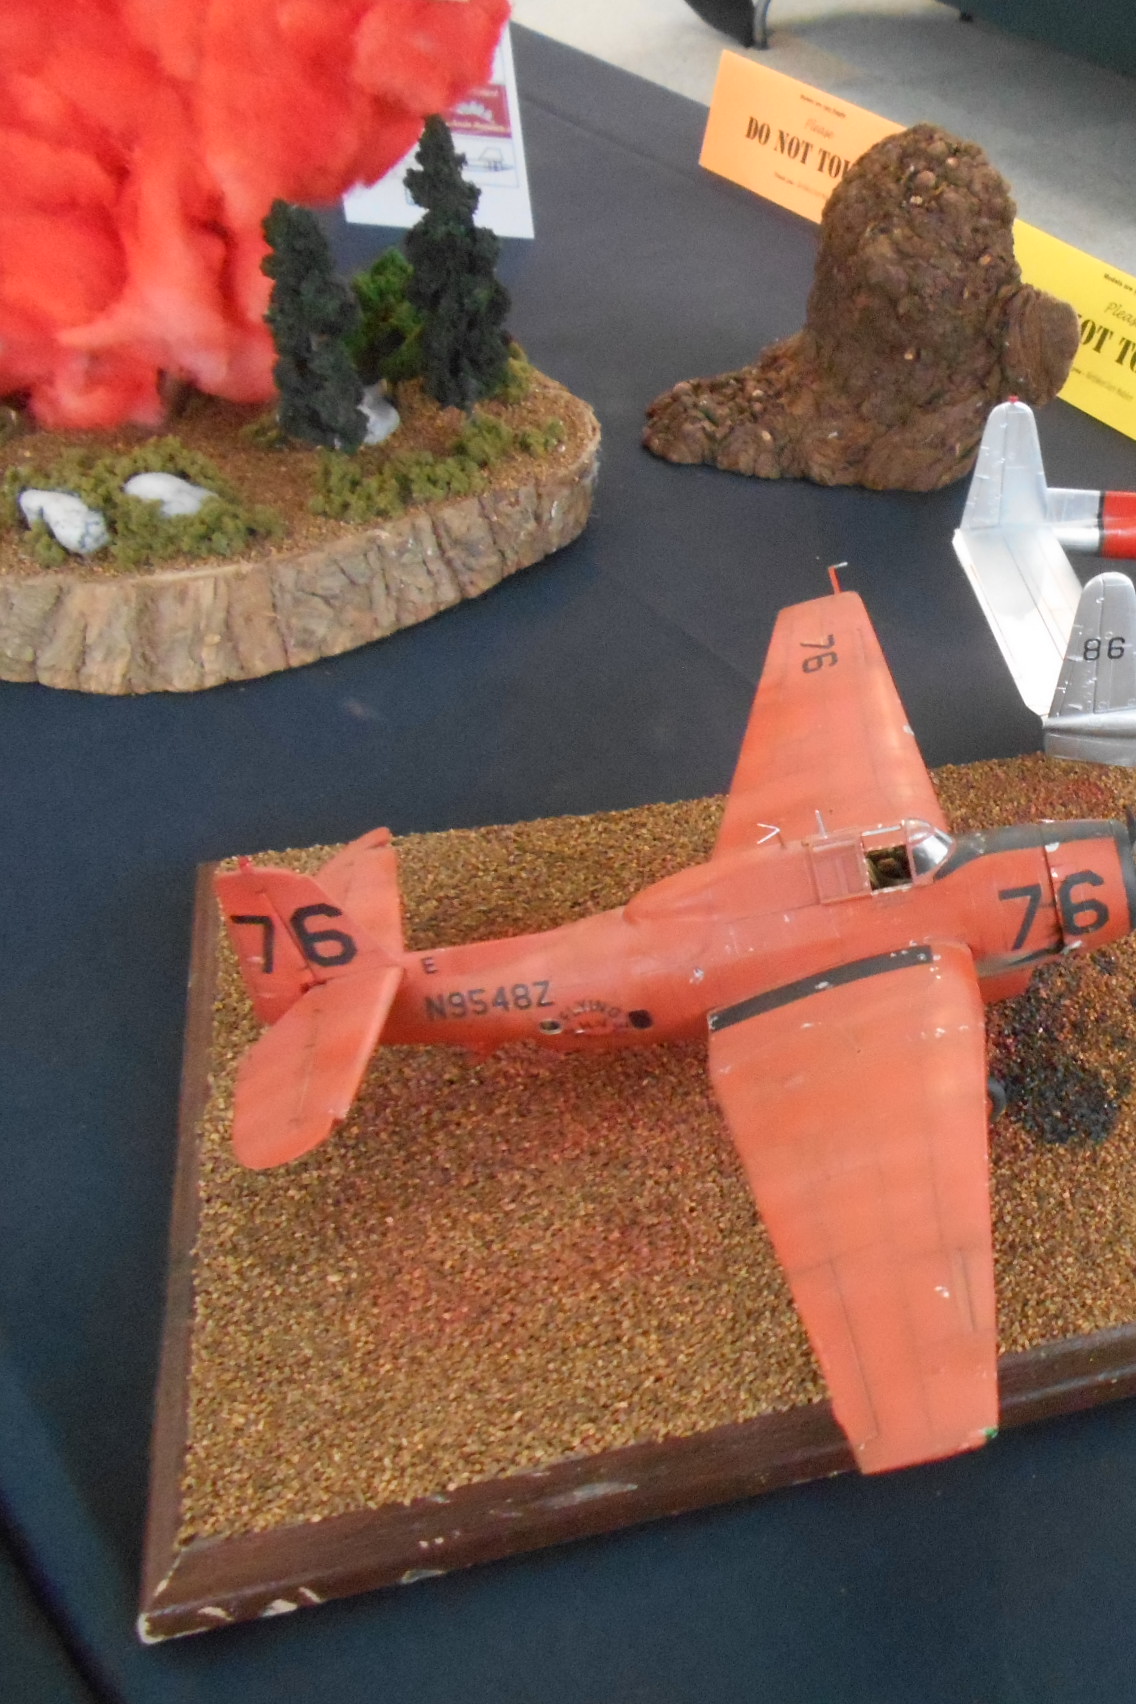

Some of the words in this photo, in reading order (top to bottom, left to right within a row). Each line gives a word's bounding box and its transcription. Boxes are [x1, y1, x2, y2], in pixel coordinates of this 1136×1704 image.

[745, 116, 771, 146] DO
[774, 129, 814, 165] NOT
[1077, 313, 1114, 354] OT
[800, 634, 839, 674] 76
[1083, 637, 1126, 661] 86
[998, 869, 1110, 951] 76
[230, 903, 358, 974] 76
[421, 956, 438, 974] E
[424, 980, 554, 1021] N9548Z
